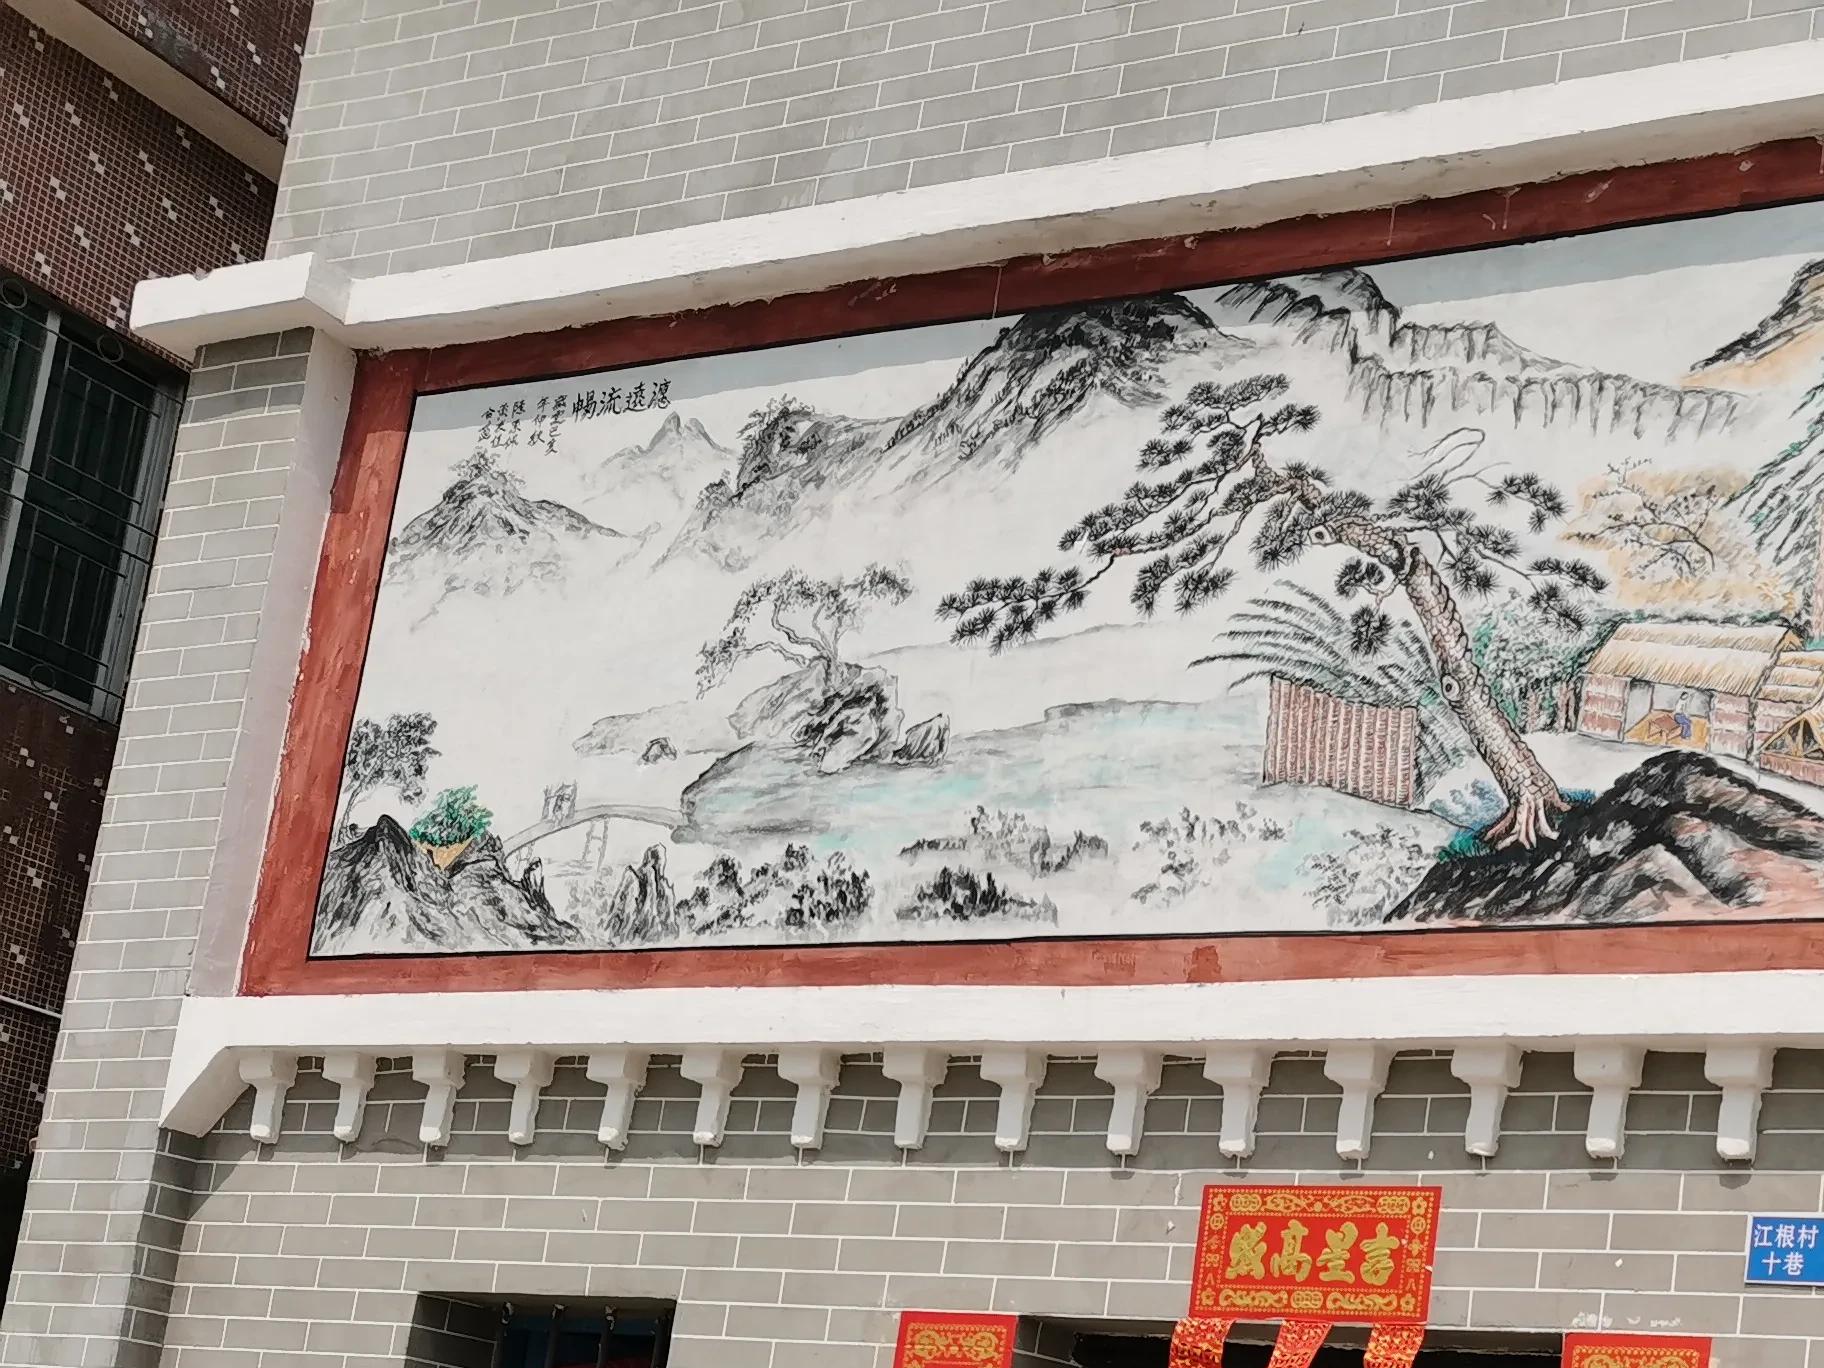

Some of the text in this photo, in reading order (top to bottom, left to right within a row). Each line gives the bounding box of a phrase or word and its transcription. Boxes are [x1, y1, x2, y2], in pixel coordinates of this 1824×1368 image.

[1753, 1224, 1819, 1249] 江根村
[1761, 1251, 1805, 1276] 十巷
